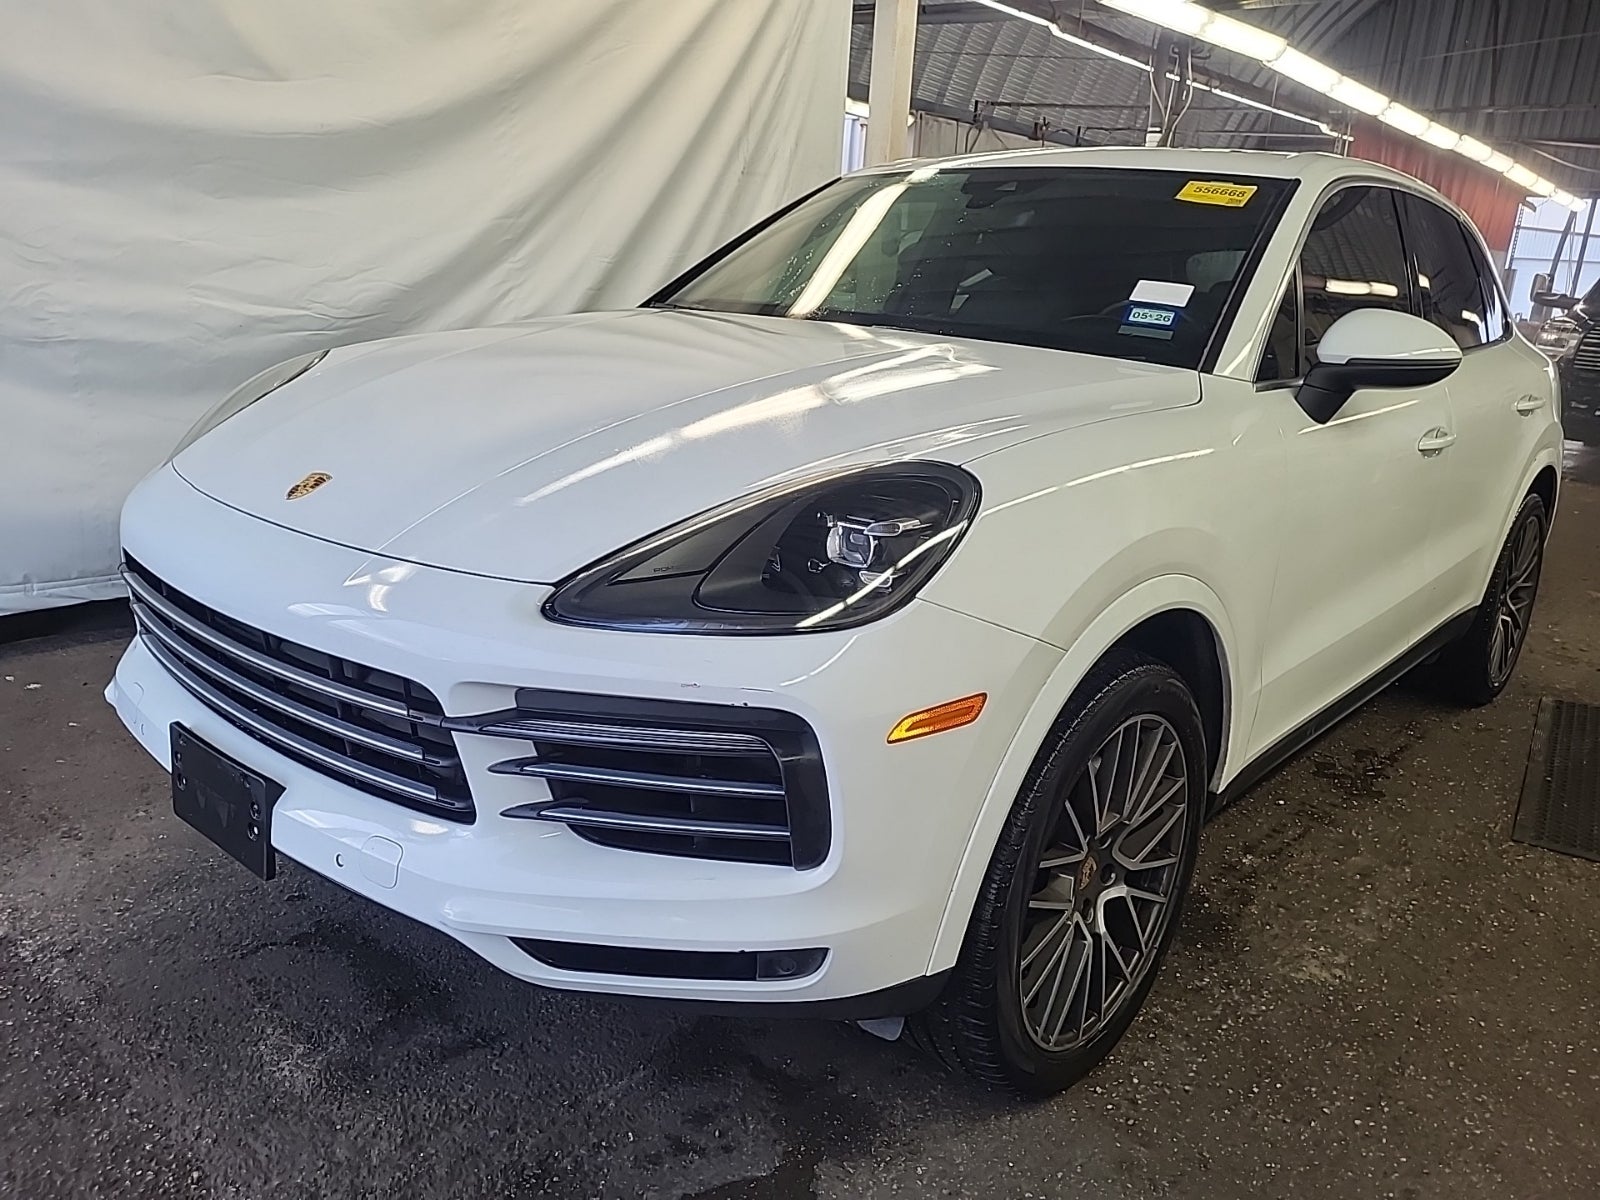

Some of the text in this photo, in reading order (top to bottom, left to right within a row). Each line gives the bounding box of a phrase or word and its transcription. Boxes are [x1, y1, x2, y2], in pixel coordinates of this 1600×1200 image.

[1193, 186, 1247, 198] 556668
[1132, 311, 1149, 320] 05
[1154, 313, 1172, 323] 26
